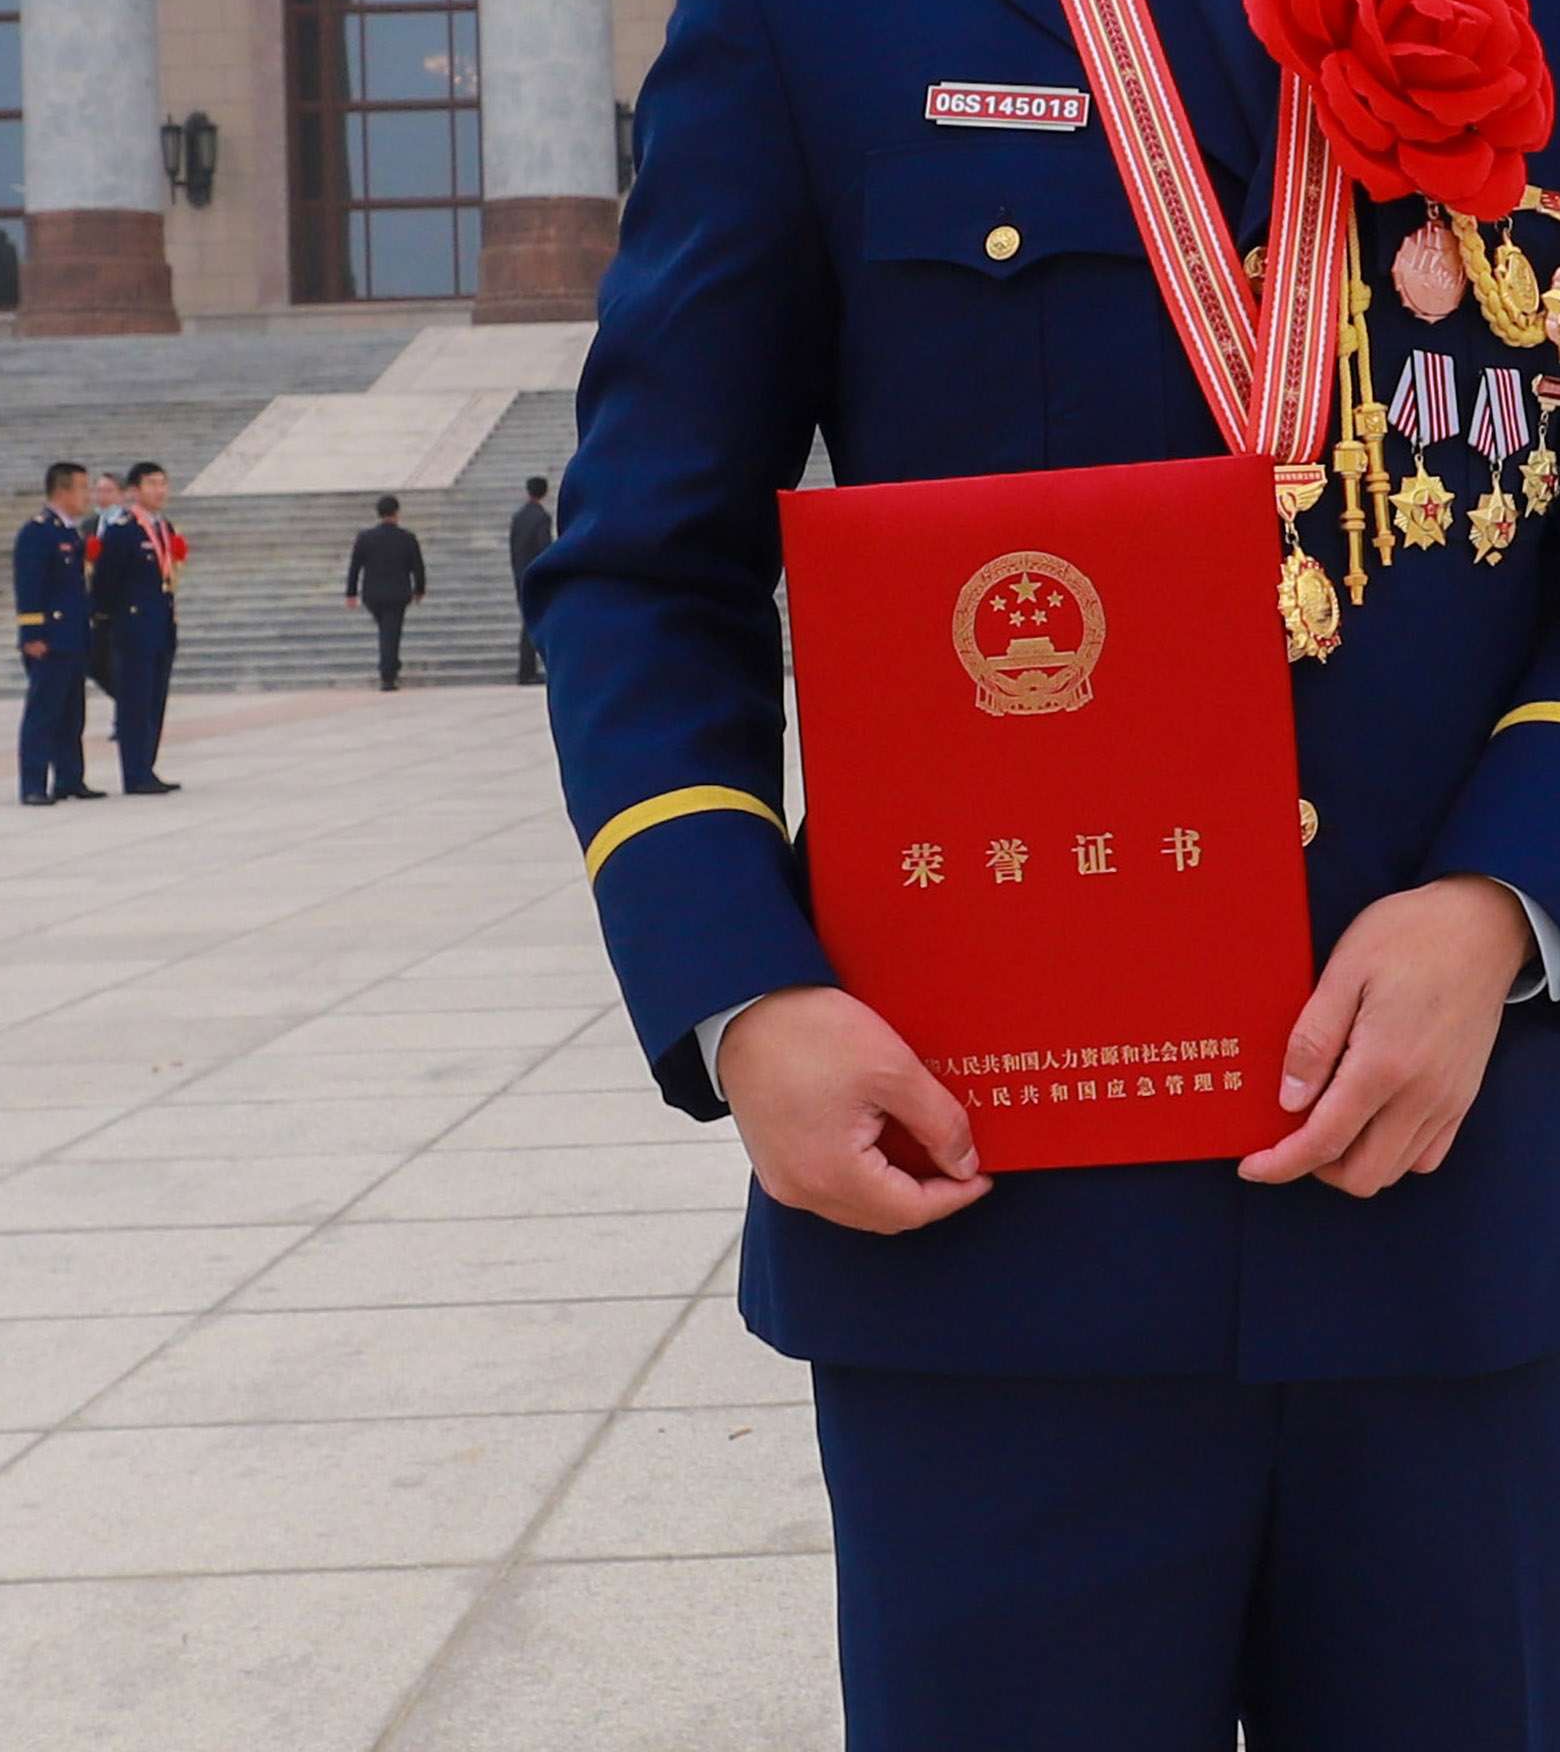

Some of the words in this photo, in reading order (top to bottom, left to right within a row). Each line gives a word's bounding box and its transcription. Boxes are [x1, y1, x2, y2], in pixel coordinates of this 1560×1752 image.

[935, 92, 1080, 119] 06S145018
[901, 827, 1201, 888] 荣誉证书
